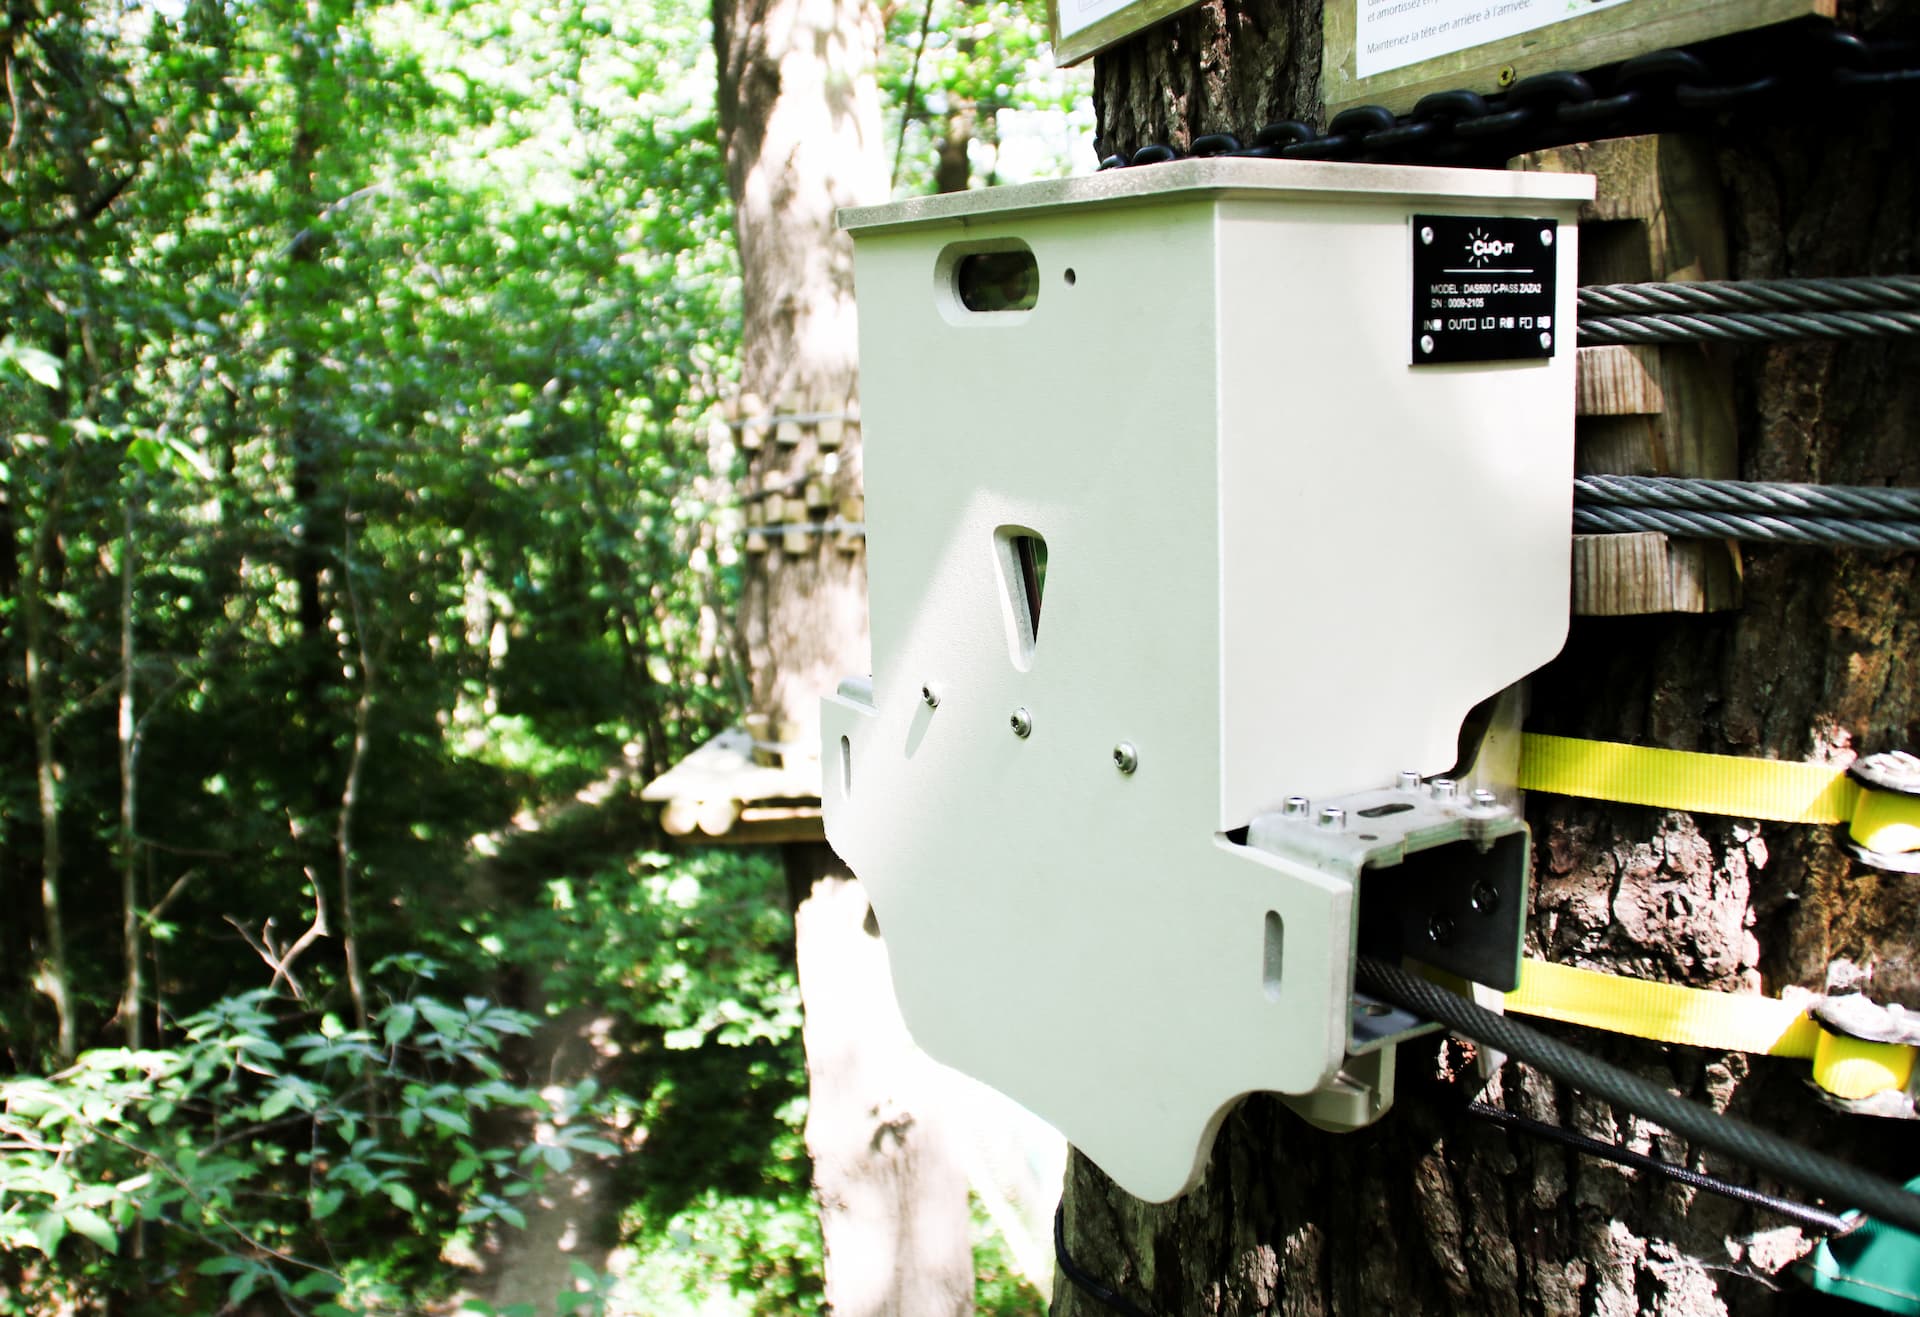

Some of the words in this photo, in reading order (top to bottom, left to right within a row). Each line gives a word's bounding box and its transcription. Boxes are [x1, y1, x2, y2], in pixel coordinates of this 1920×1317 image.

[1367, 34, 1410, 55] Maintenez
[1411, 31, 1419, 41] la
[1438, 21, 1450, 33] en
[1451, 12, 1482, 30] arrière
[1431, 284, 1458, 294] MODEL
[1492, 283, 1519, 294] C-PASS
[1431, 298, 1443, 308] SN
